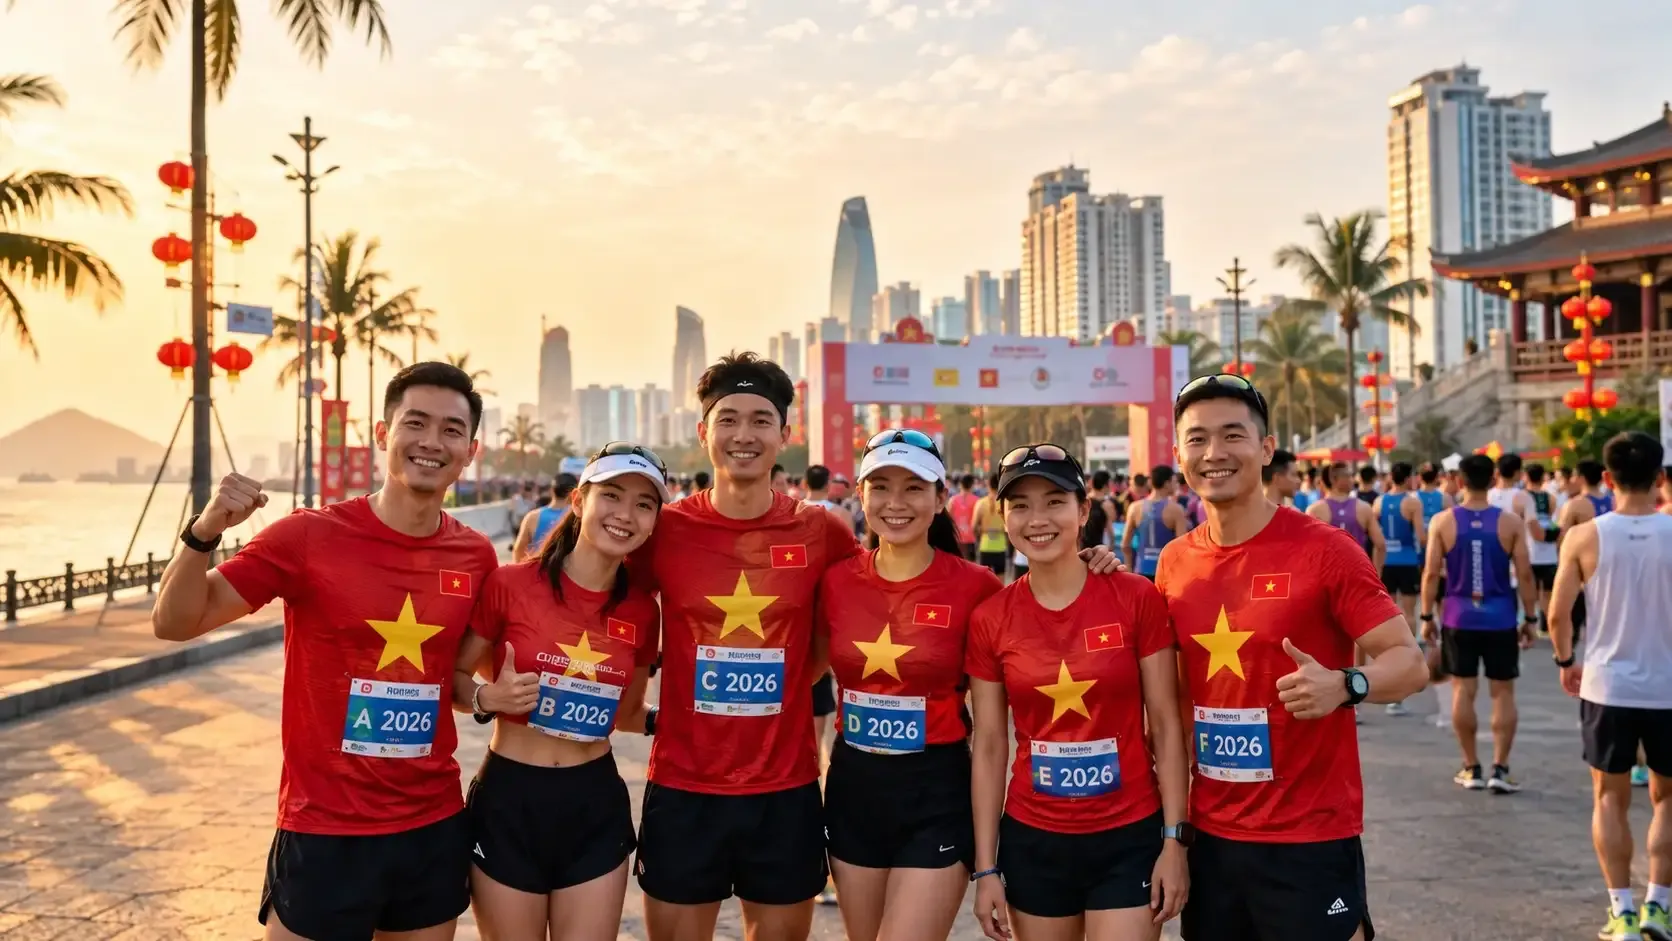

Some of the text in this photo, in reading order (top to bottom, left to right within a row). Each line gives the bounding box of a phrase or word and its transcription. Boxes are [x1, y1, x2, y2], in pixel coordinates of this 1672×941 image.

[701, 670, 777, 692] C 2026
[352, 708, 432, 732] A 2026
[538, 696, 610, 726] B 2026
[848, 713, 919, 740] D 2026
[1199, 732, 1263, 757] F 2026
[1038, 765, 1114, 787] E 2026
